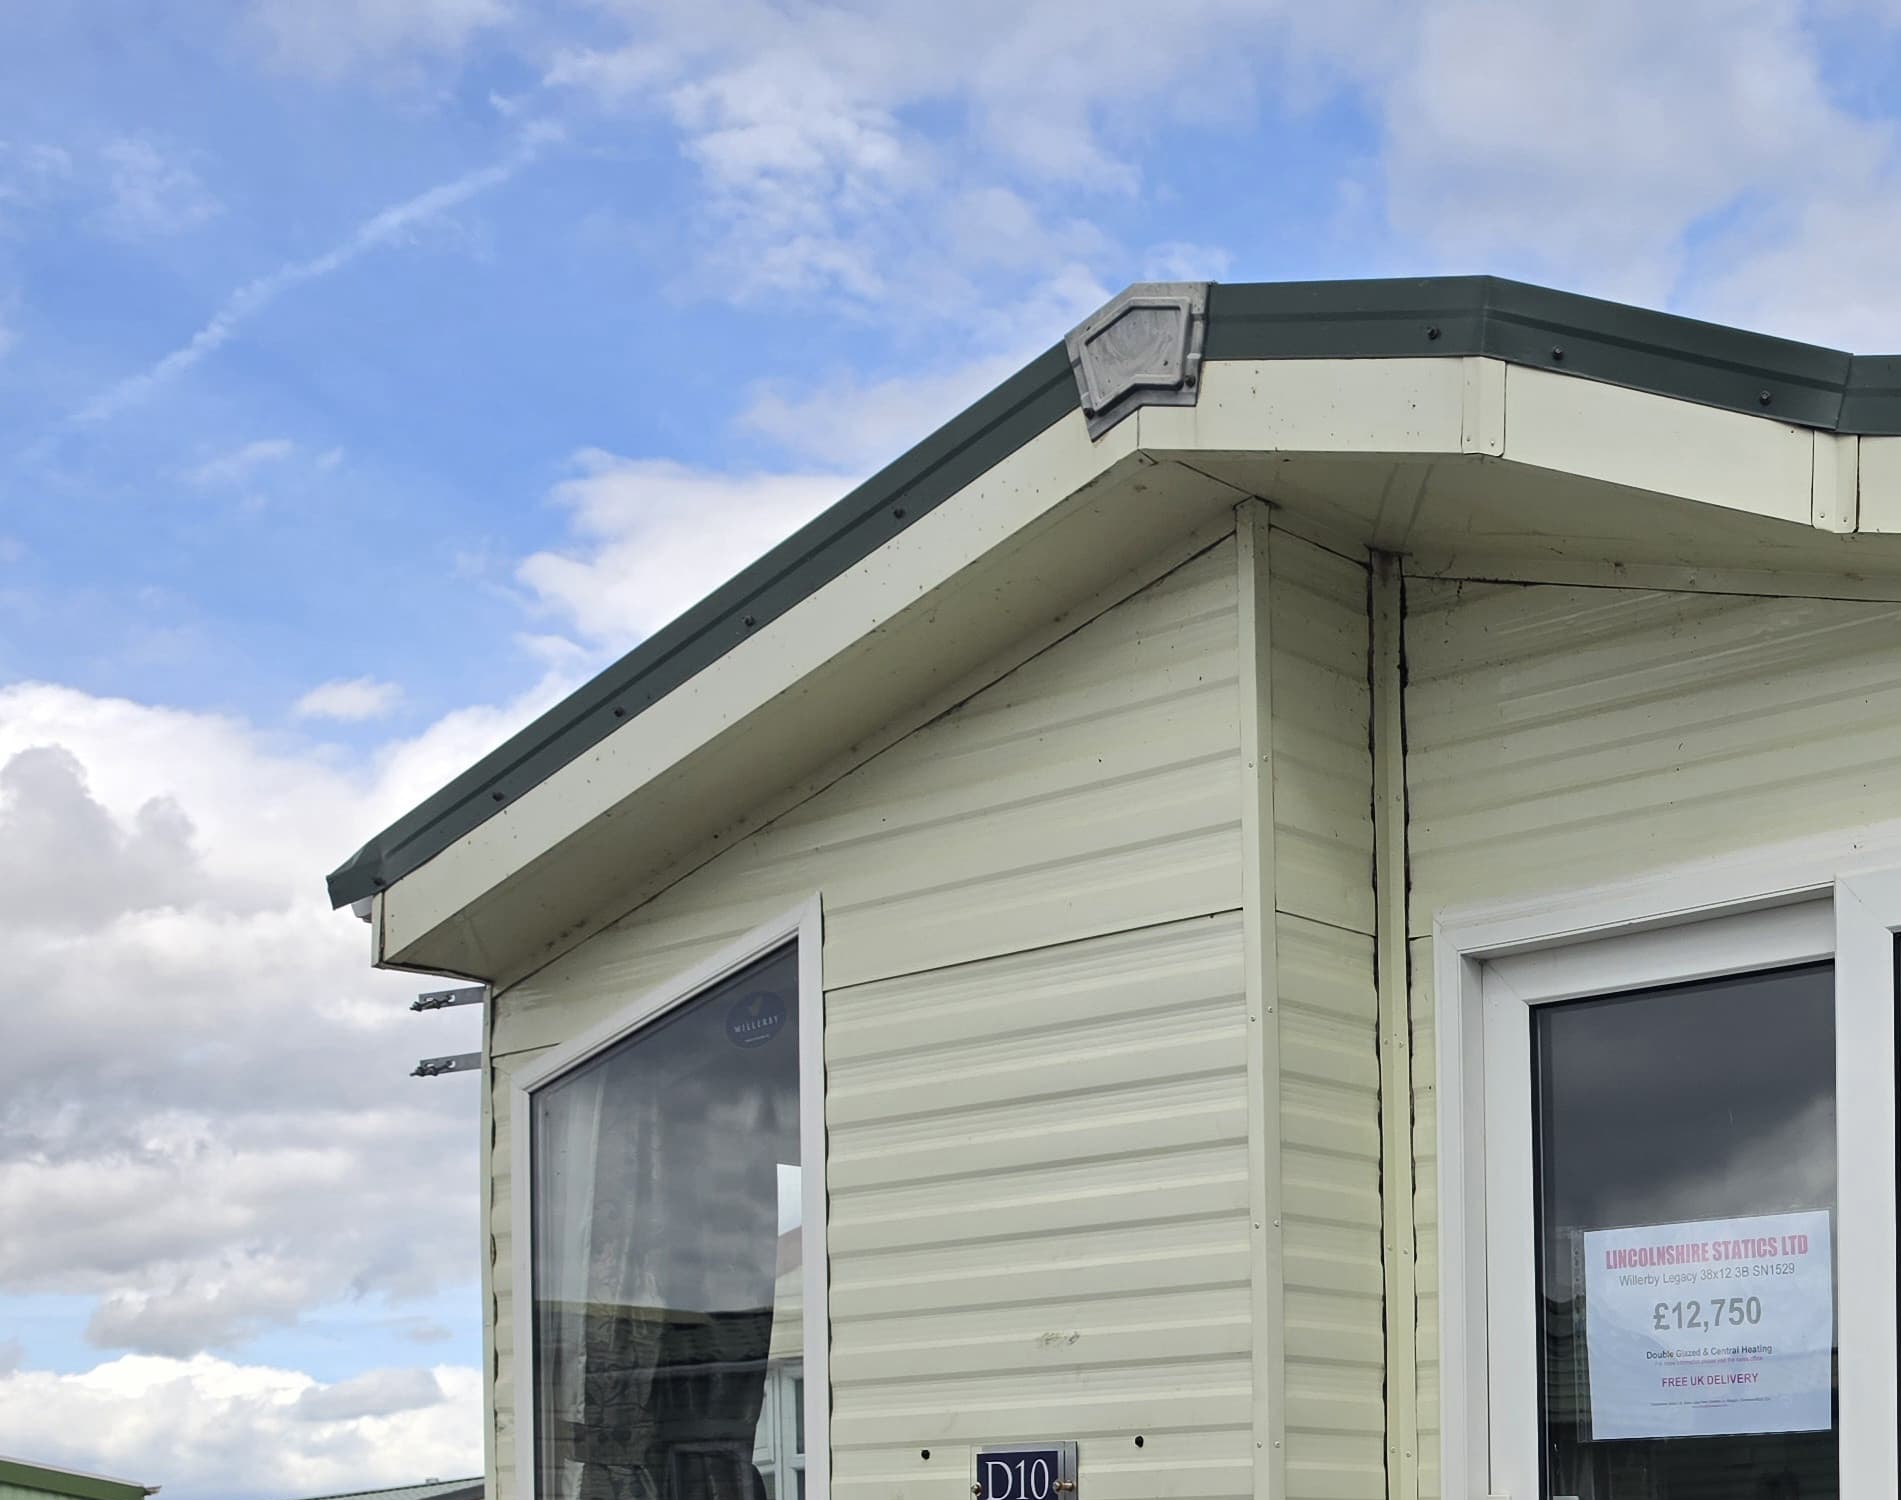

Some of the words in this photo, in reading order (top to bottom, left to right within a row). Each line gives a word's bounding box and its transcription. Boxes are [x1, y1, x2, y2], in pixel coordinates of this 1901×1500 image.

[1606, 1242, 1709, 1270] LINCOLNSHIRE
[1712, 1237, 1778, 1261] STATICS
[1781, 1234, 1808, 1256] LTD
[1619, 1273, 1659, 1287] Willerby
[1663, 1272, 1698, 1285] Legacy
[1700, 1267, 1732, 1281] 38x12
[1735, 1266, 1749, 1278] 3B
[1752, 1262, 1795, 1277] SN1529
[1652, 1296, 1762, 1333] £12,750
[1646, 1350, 1674, 1359] Double
[1702, 1347, 1709, 1356] &
[1710, 1345, 1739, 1356] Central
[1741, 1344, 1773, 1355] Heating
[1661, 1376, 1688, 1388] FREE
[1690, 1375, 1705, 1386] UK
[1706, 1372, 1759, 1385] DELIVERY
